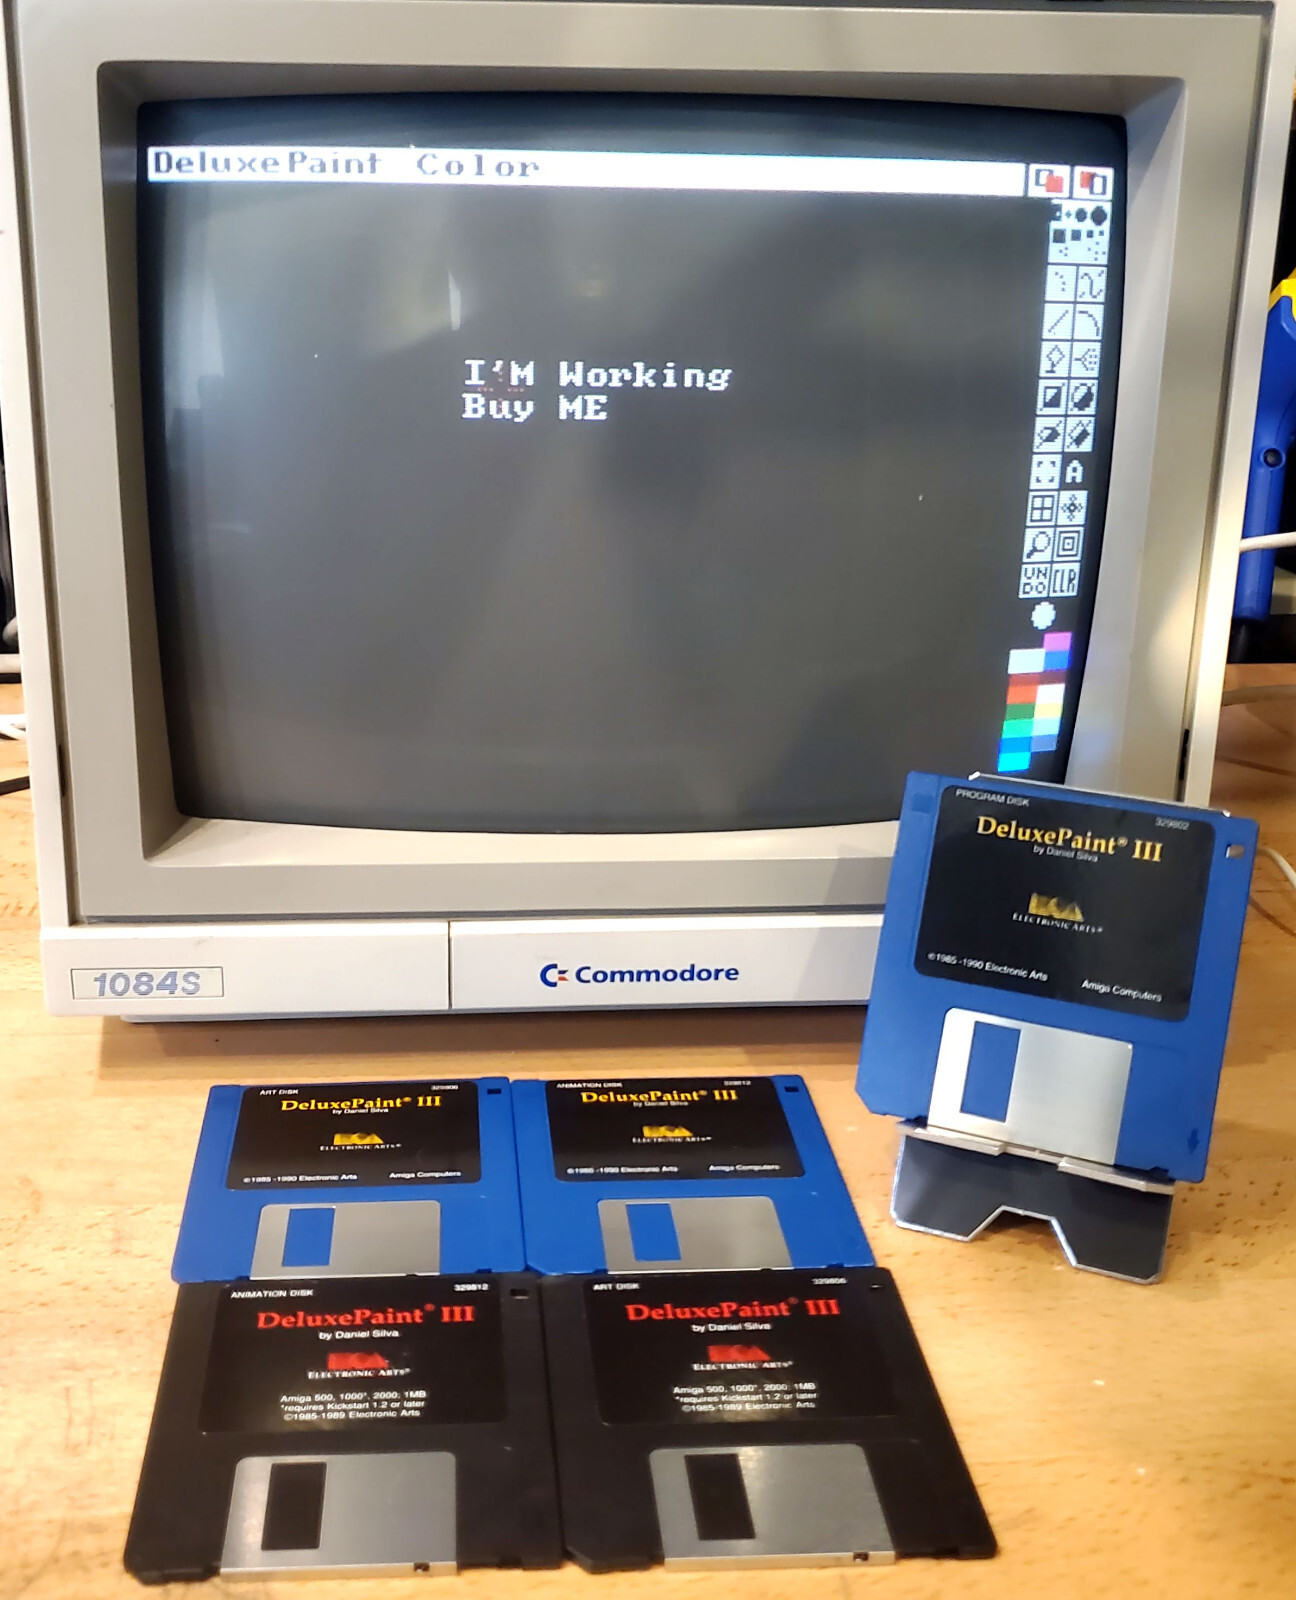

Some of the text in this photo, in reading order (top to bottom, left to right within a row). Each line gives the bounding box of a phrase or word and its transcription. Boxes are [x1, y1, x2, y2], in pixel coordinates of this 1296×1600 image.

[154, 151, 540, 177] DeluxePaint Color
[464, 359, 733, 391] I'M Working
[461, 392, 608, 423] Buy ME
[955, 788, 1030, 807] PROGRAM DISK
[1033, 844, 1098, 863] by Daniel Silva
[1132, 838, 1163, 862] III
[1012, 912, 1071, 930] ELECTRONIC
[575, 963, 740, 984] Commodore
[985, 961, 1028, 978] Electronic
[1028, 969, 1049, 982] Arts
[93, 970, 201, 997] 1084S
[1081, 979, 1162, 1003] Amiga Computers
[417, 1095, 442, 1108] III
[713, 1089, 739, 1101] III
[298, 1174, 340, 1182] Electronic
[340, 1173, 358, 1181] Arts
[389, 1172, 416, 1180] Amiga
[593, 1282, 640, 1291] ART DISK
[231, 1289, 314, 1299] ANIMATION DISK
[804, 1298, 841, 1315] III
[441, 1305, 475, 1322] III
[691, 1322, 772, 1333] by Daniel Silva
[318, 1329, 399, 1341] by Daniel Silva
[692, 1362, 757, 1371] ELECTRONIC
[307, 1370, 374, 1380] ELECTRONIC
[673, 1386, 704, 1395] Amiga
[793, 1382, 816, 1390] 1MB
[280, 1394, 312, 1404] Amiga
[404, 1390, 426, 1398] 1MB
[721, 1393, 763, 1402] Kickstart
[796, 1392, 818, 1400] later
[327, 1401, 369, 1410] Kickstart
[404, 1400, 425, 1408] later
[745, 1402, 792, 1410] Electronic
[796, 1401, 816, 1409] Arts
[348, 1410, 397, 1419] Electronic
[400, 1409, 421, 1417] Arts
